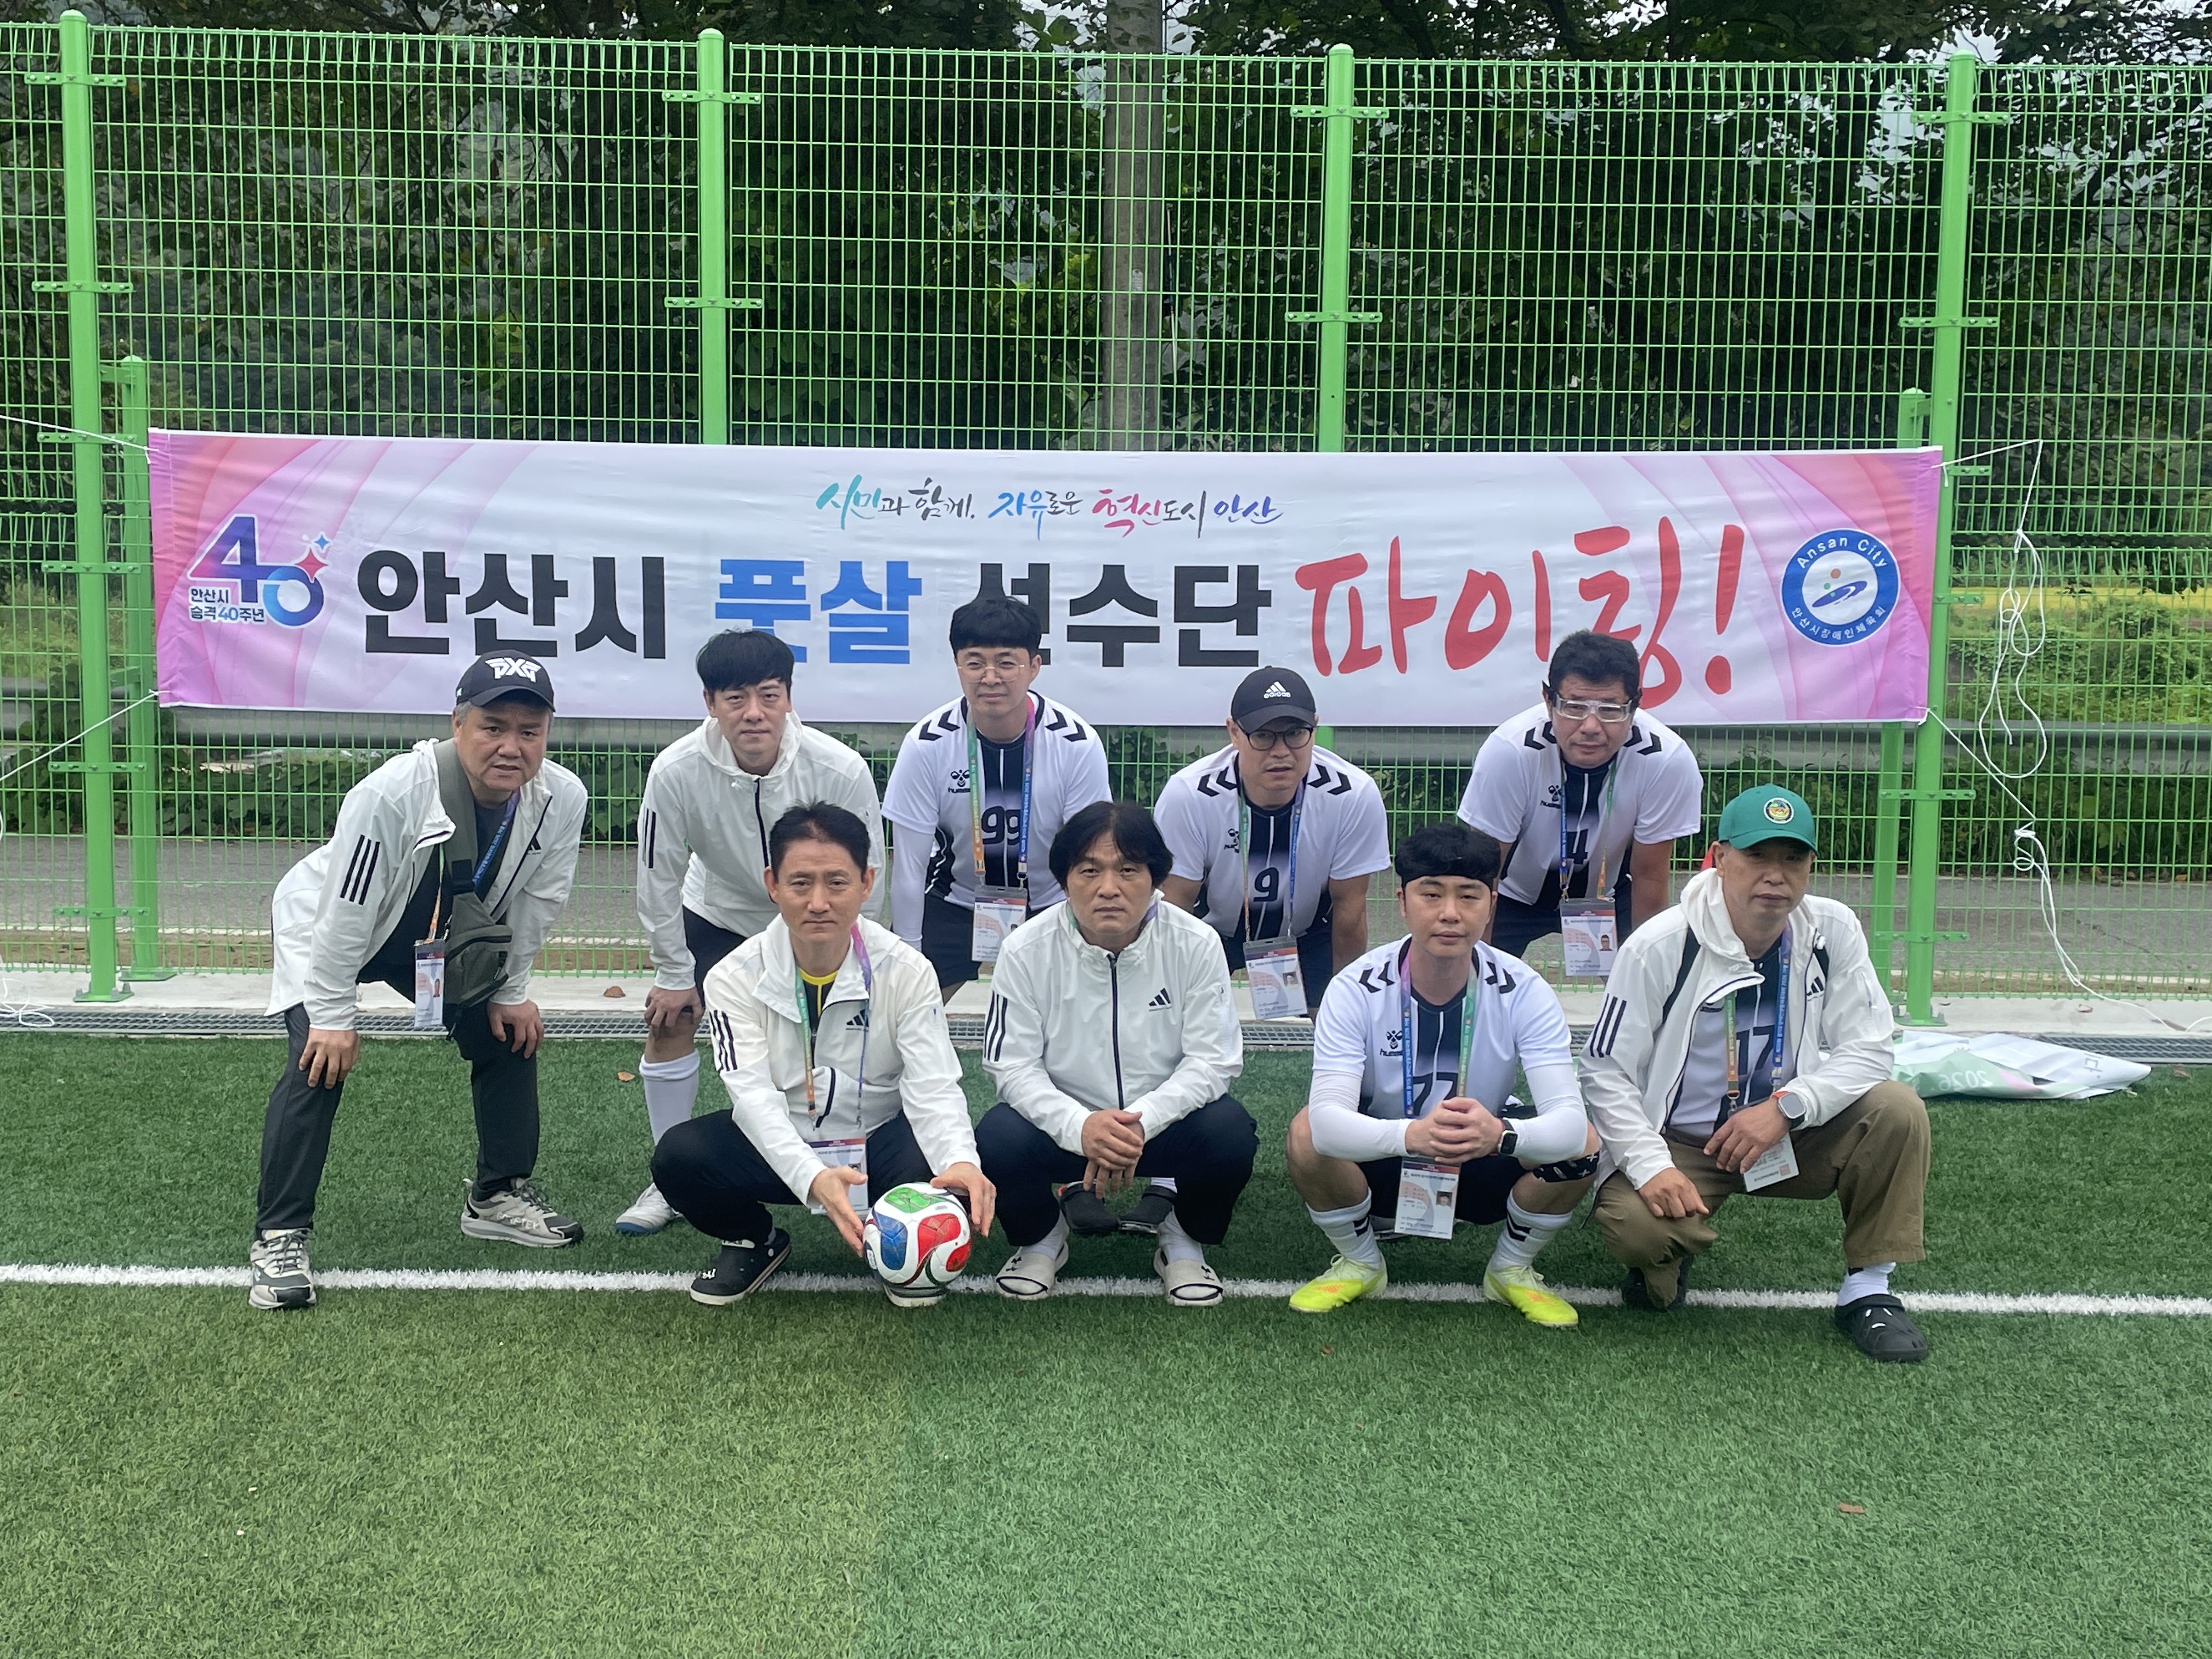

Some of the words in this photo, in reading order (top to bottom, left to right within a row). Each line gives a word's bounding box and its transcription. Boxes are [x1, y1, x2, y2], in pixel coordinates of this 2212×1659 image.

[815, 474, 911, 531] 시민과
[988, 489, 1084, 541] 자유로운
[1092, 488, 1207, 539] 혁신도시
[1214, 494, 1284, 525] 안산
[1796, 537, 1848, 569] Ansan
[1857, 538, 1888, 568] City
[190, 588, 229, 603] 안산시
[357, 549, 667, 659] 안산시
[715, 558, 922, 665] 풋살
[1295, 516, 1745, 710] 파이팅!
[1791, 606, 1886, 641] 안산시장애인체육회
[485, 657, 541, 682] PXG
[1263, 691, 1291, 699] adidas
[981, 805, 1022, 845] 99
[1253, 867, 1279, 902] 9
[1736, 1024, 1775, 1076] 17
[1413, 1071, 1459, 1117] 77
